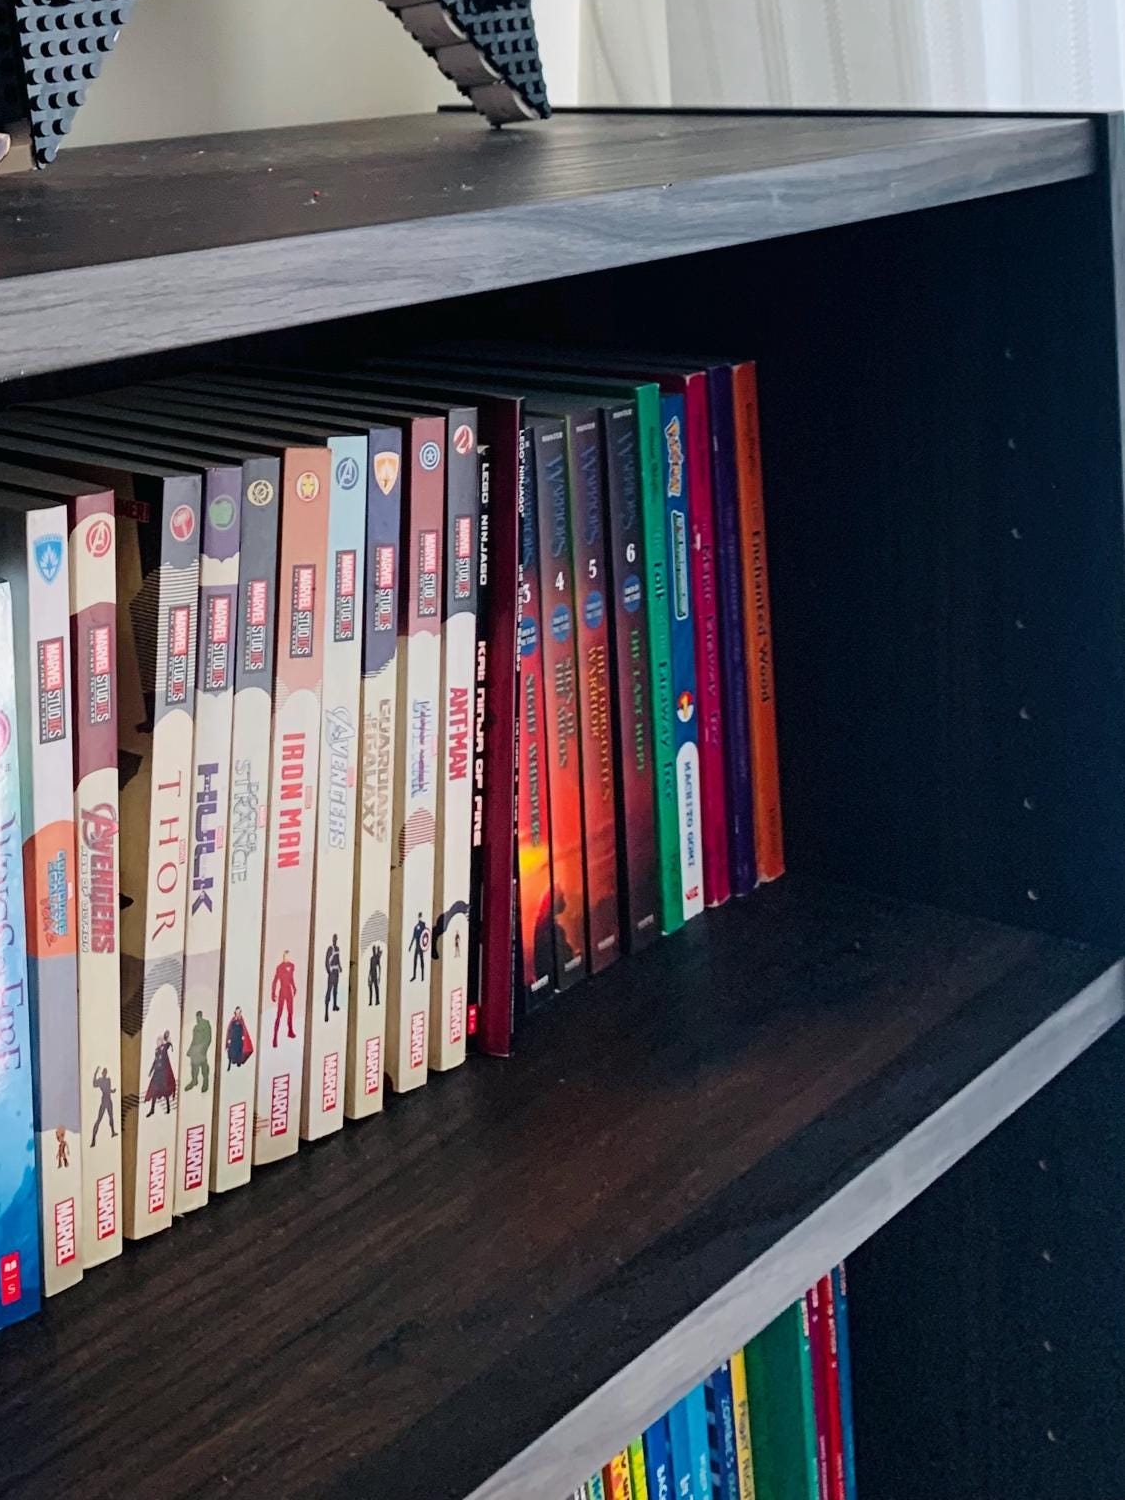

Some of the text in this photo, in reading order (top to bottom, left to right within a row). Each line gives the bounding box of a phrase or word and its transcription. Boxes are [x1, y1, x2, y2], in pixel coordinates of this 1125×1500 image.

[423, 532, 439, 572] MARVEL
[457, 517, 473, 558] MARVEL
[479, 462, 490, 586] LEGO NINJAGO
[625, 542, 636, 563] 6
[298, 569, 314, 611] MARVEL
[339, 553, 355, 596] MARVEL
[379, 546, 395, 588] MARVEL
[555, 571, 565, 591] 4
[588, 558, 598, 579] 5
[172, 609, 188, 653] MARVEL
[211, 597, 229, 642] MARVEL
[250, 581, 267, 624] MARVEL
[46, 642, 62, 688] MARVEL
[94, 627, 111, 673] MARVEL
[449, 687, 469, 781] ANT-MAN
[473, 640, 487, 847] KAI: NINJA OF FIRE
[277, 732, 307, 869] IRON MAN
[325, 706, 356, 850] AVENGERS
[362, 732, 377, 838] GALAXY
[376, 698, 392, 842] GUARDIANS
[192, 763, 220, 917] HULK
[231, 759, 252, 884] STRANGE
[81, 802, 119, 954] AVENGERS
[151, 770, 183, 941] THOR
[410, 1011, 425, 1069] MARVEL
[450, 988, 463, 1044] MARVEL
[323, 1052, 338, 1112] MARVEL
[365, 1036, 380, 1095] MARVEL
[228, 1102, 246, 1164] MARVEL
[271, 1074, 290, 1137] MARVEL
[149, 1148, 166, 1213] MARVEL
[185, 1125, 205, 1190] MARVEL
[56, 1198, 75, 1266] MARVEL
[97, 1173, 116, 1240] MARVEL
